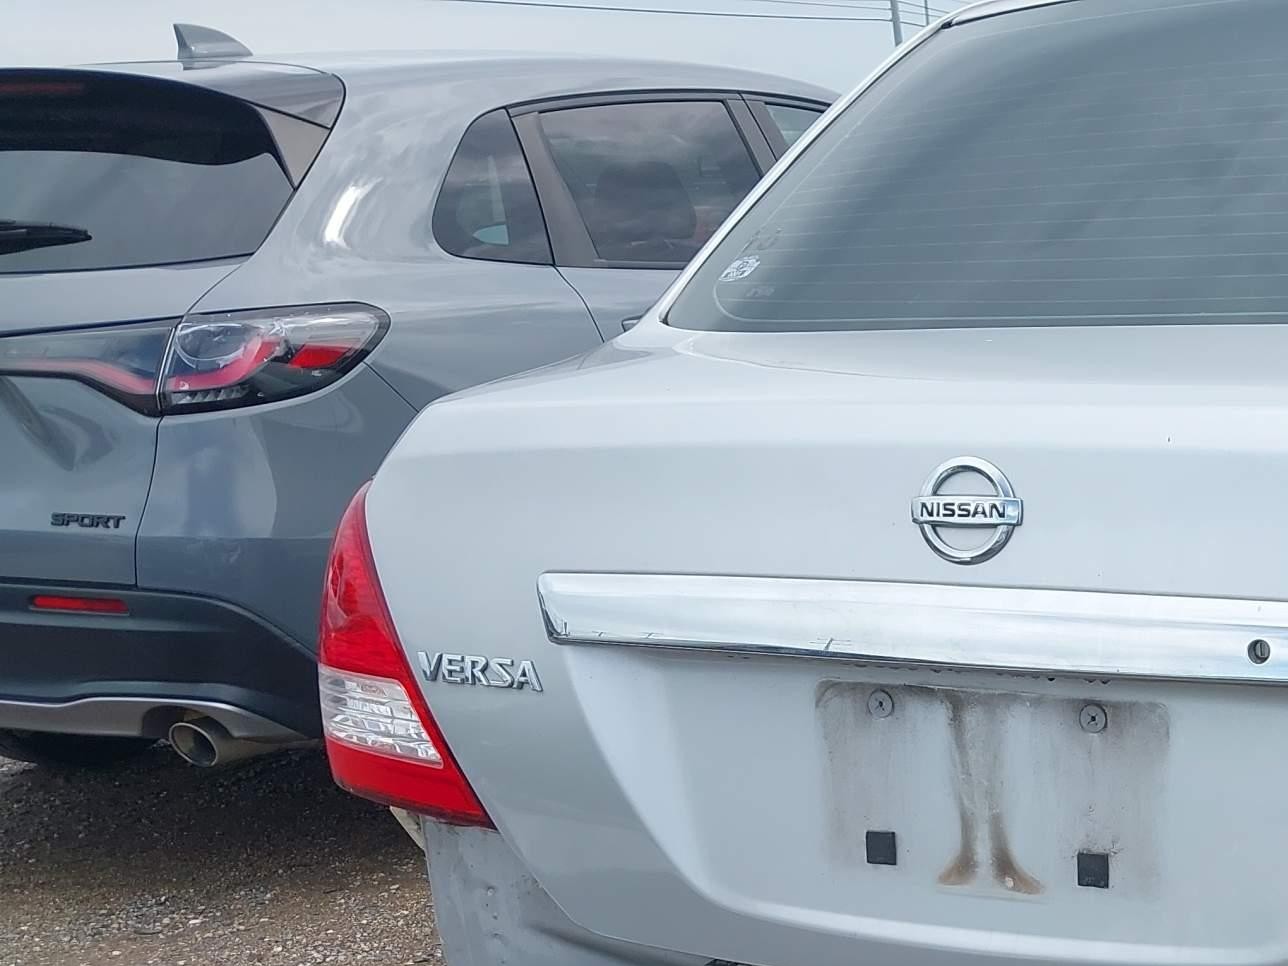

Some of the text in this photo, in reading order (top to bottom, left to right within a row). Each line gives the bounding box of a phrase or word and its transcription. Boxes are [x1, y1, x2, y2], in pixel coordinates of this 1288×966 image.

[919, 501, 1006, 519] NISSAN
[51, 512, 126, 530] SPORT
[417, 651, 544, 692] VERSA
